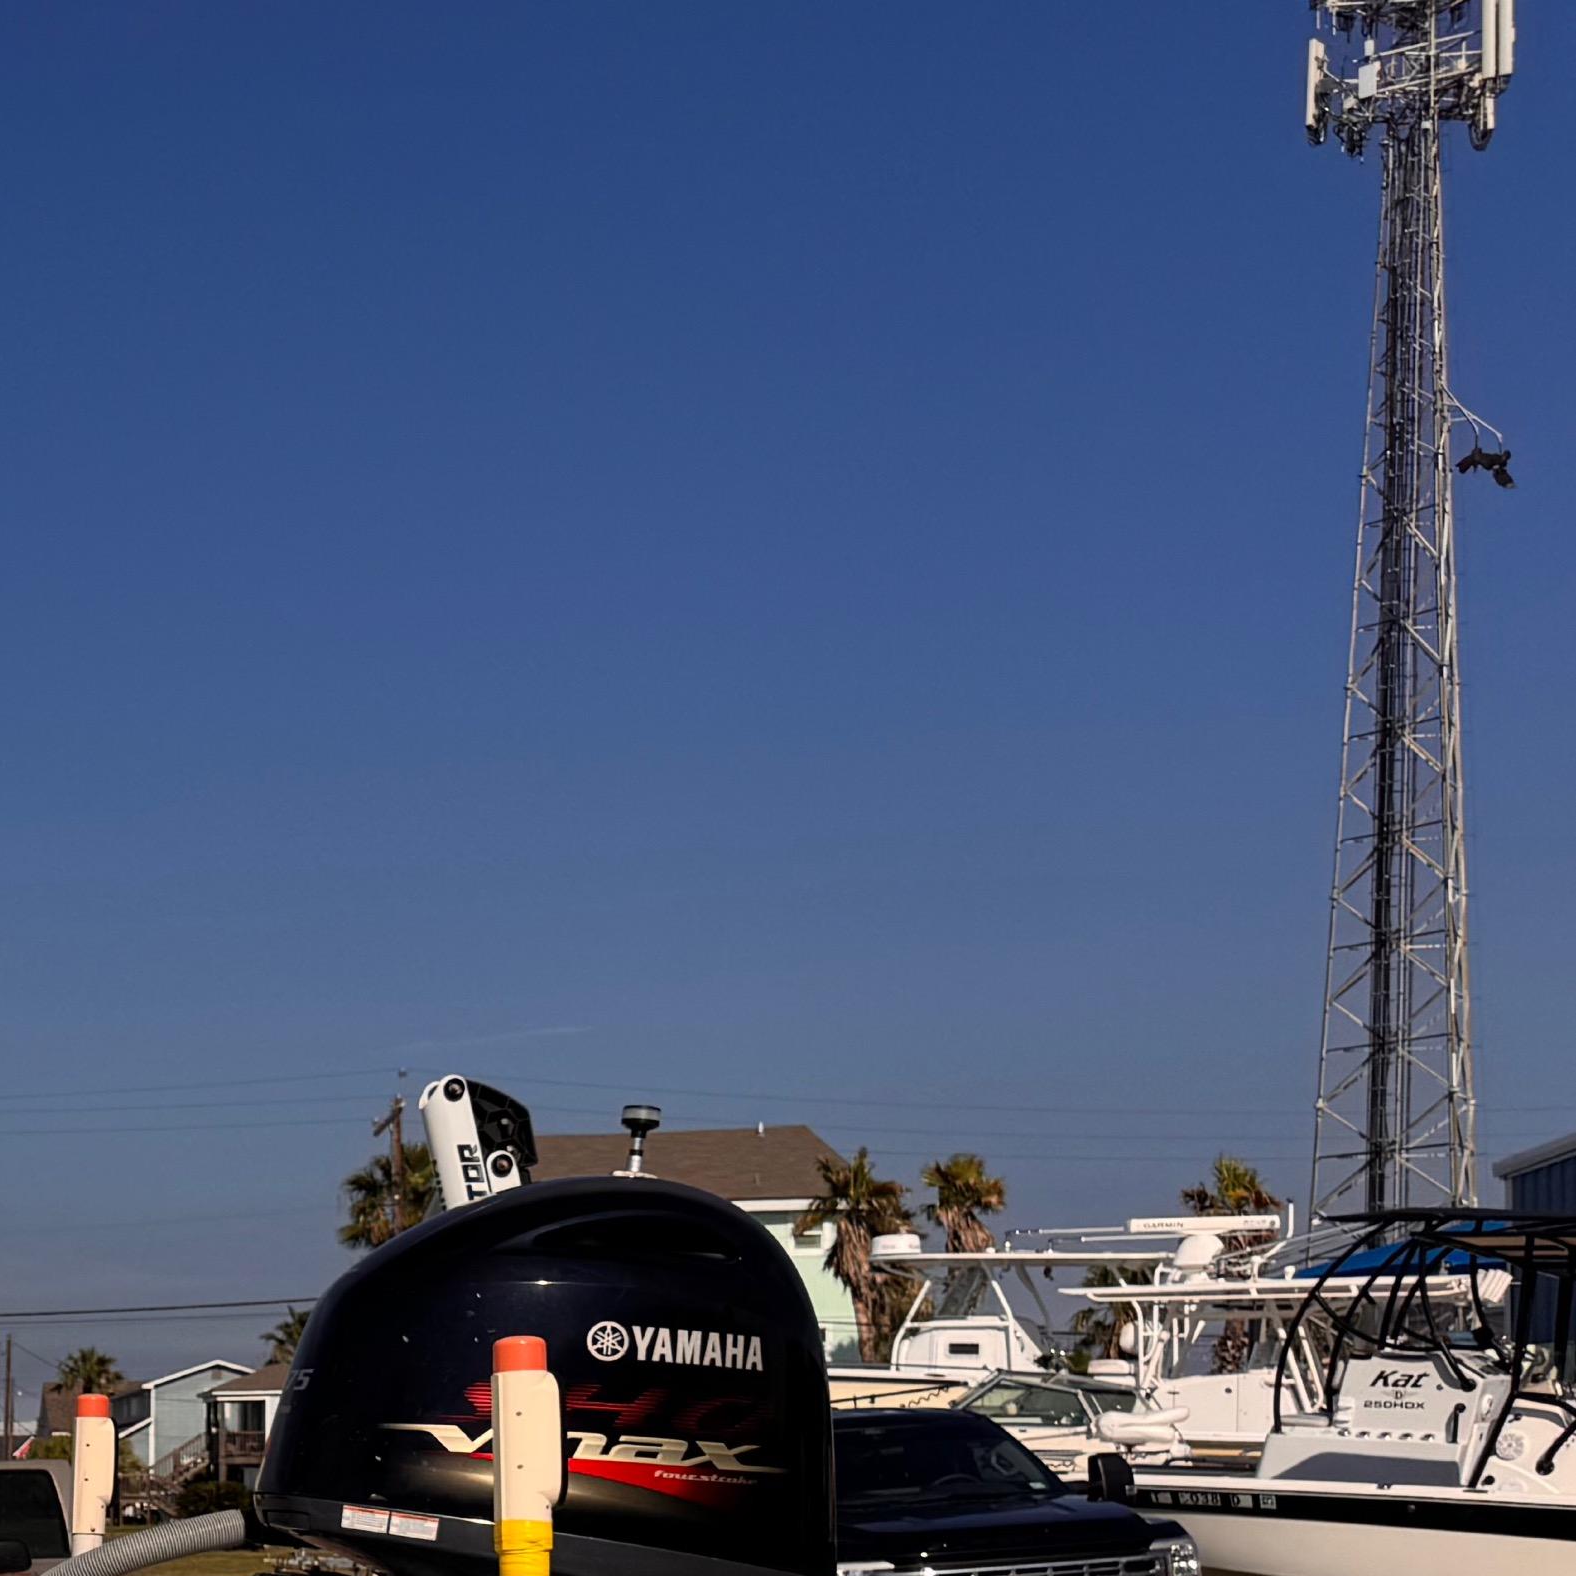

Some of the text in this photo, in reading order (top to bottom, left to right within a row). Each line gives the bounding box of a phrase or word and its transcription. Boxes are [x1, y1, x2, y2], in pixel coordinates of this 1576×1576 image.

[631, 1325, 764, 1372] YAMAHA
[1369, 1370, 1430, 1388] Kat
[1364, 1401, 1425, 1409] 250HDX
